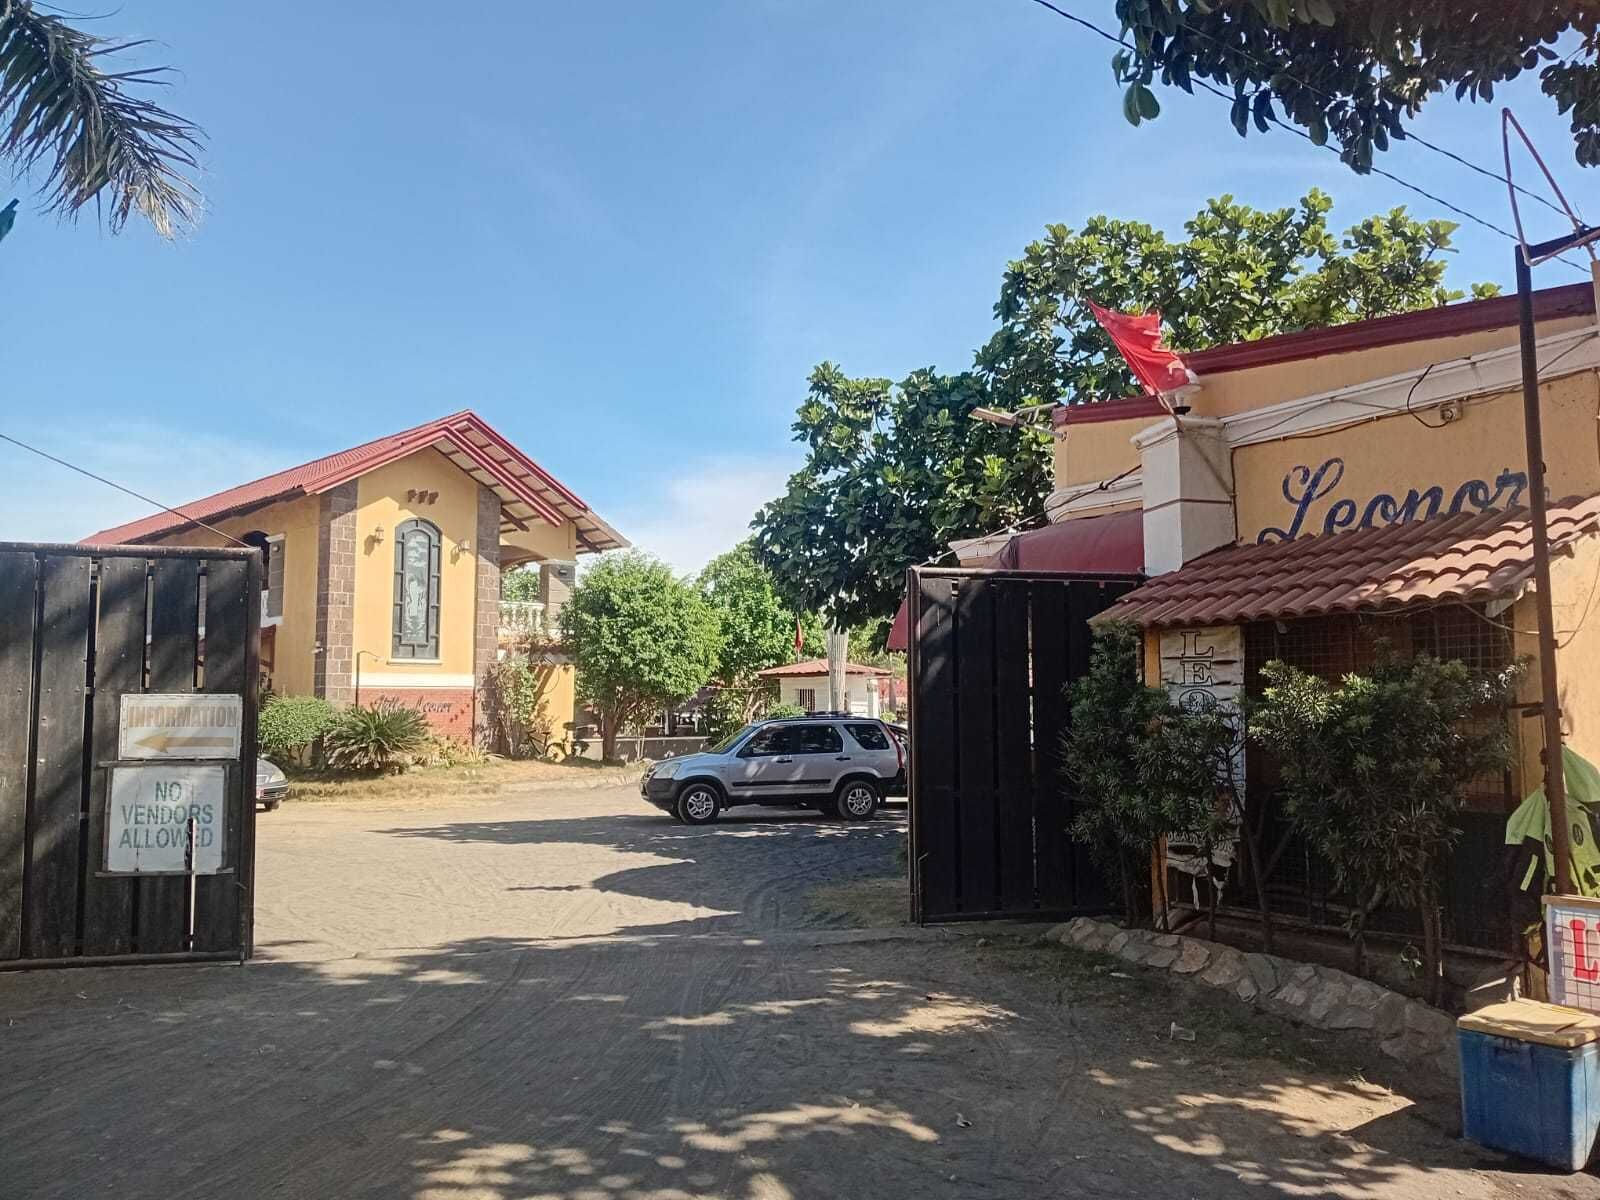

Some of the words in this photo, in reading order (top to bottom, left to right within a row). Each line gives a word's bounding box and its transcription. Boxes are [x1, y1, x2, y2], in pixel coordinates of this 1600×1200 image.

[1257, 457, 1528, 544] Leonor
[127, 705, 237, 728] INFORMATION
[155, 781, 182, 802] NO
[121, 804, 214, 825] VENDORS
